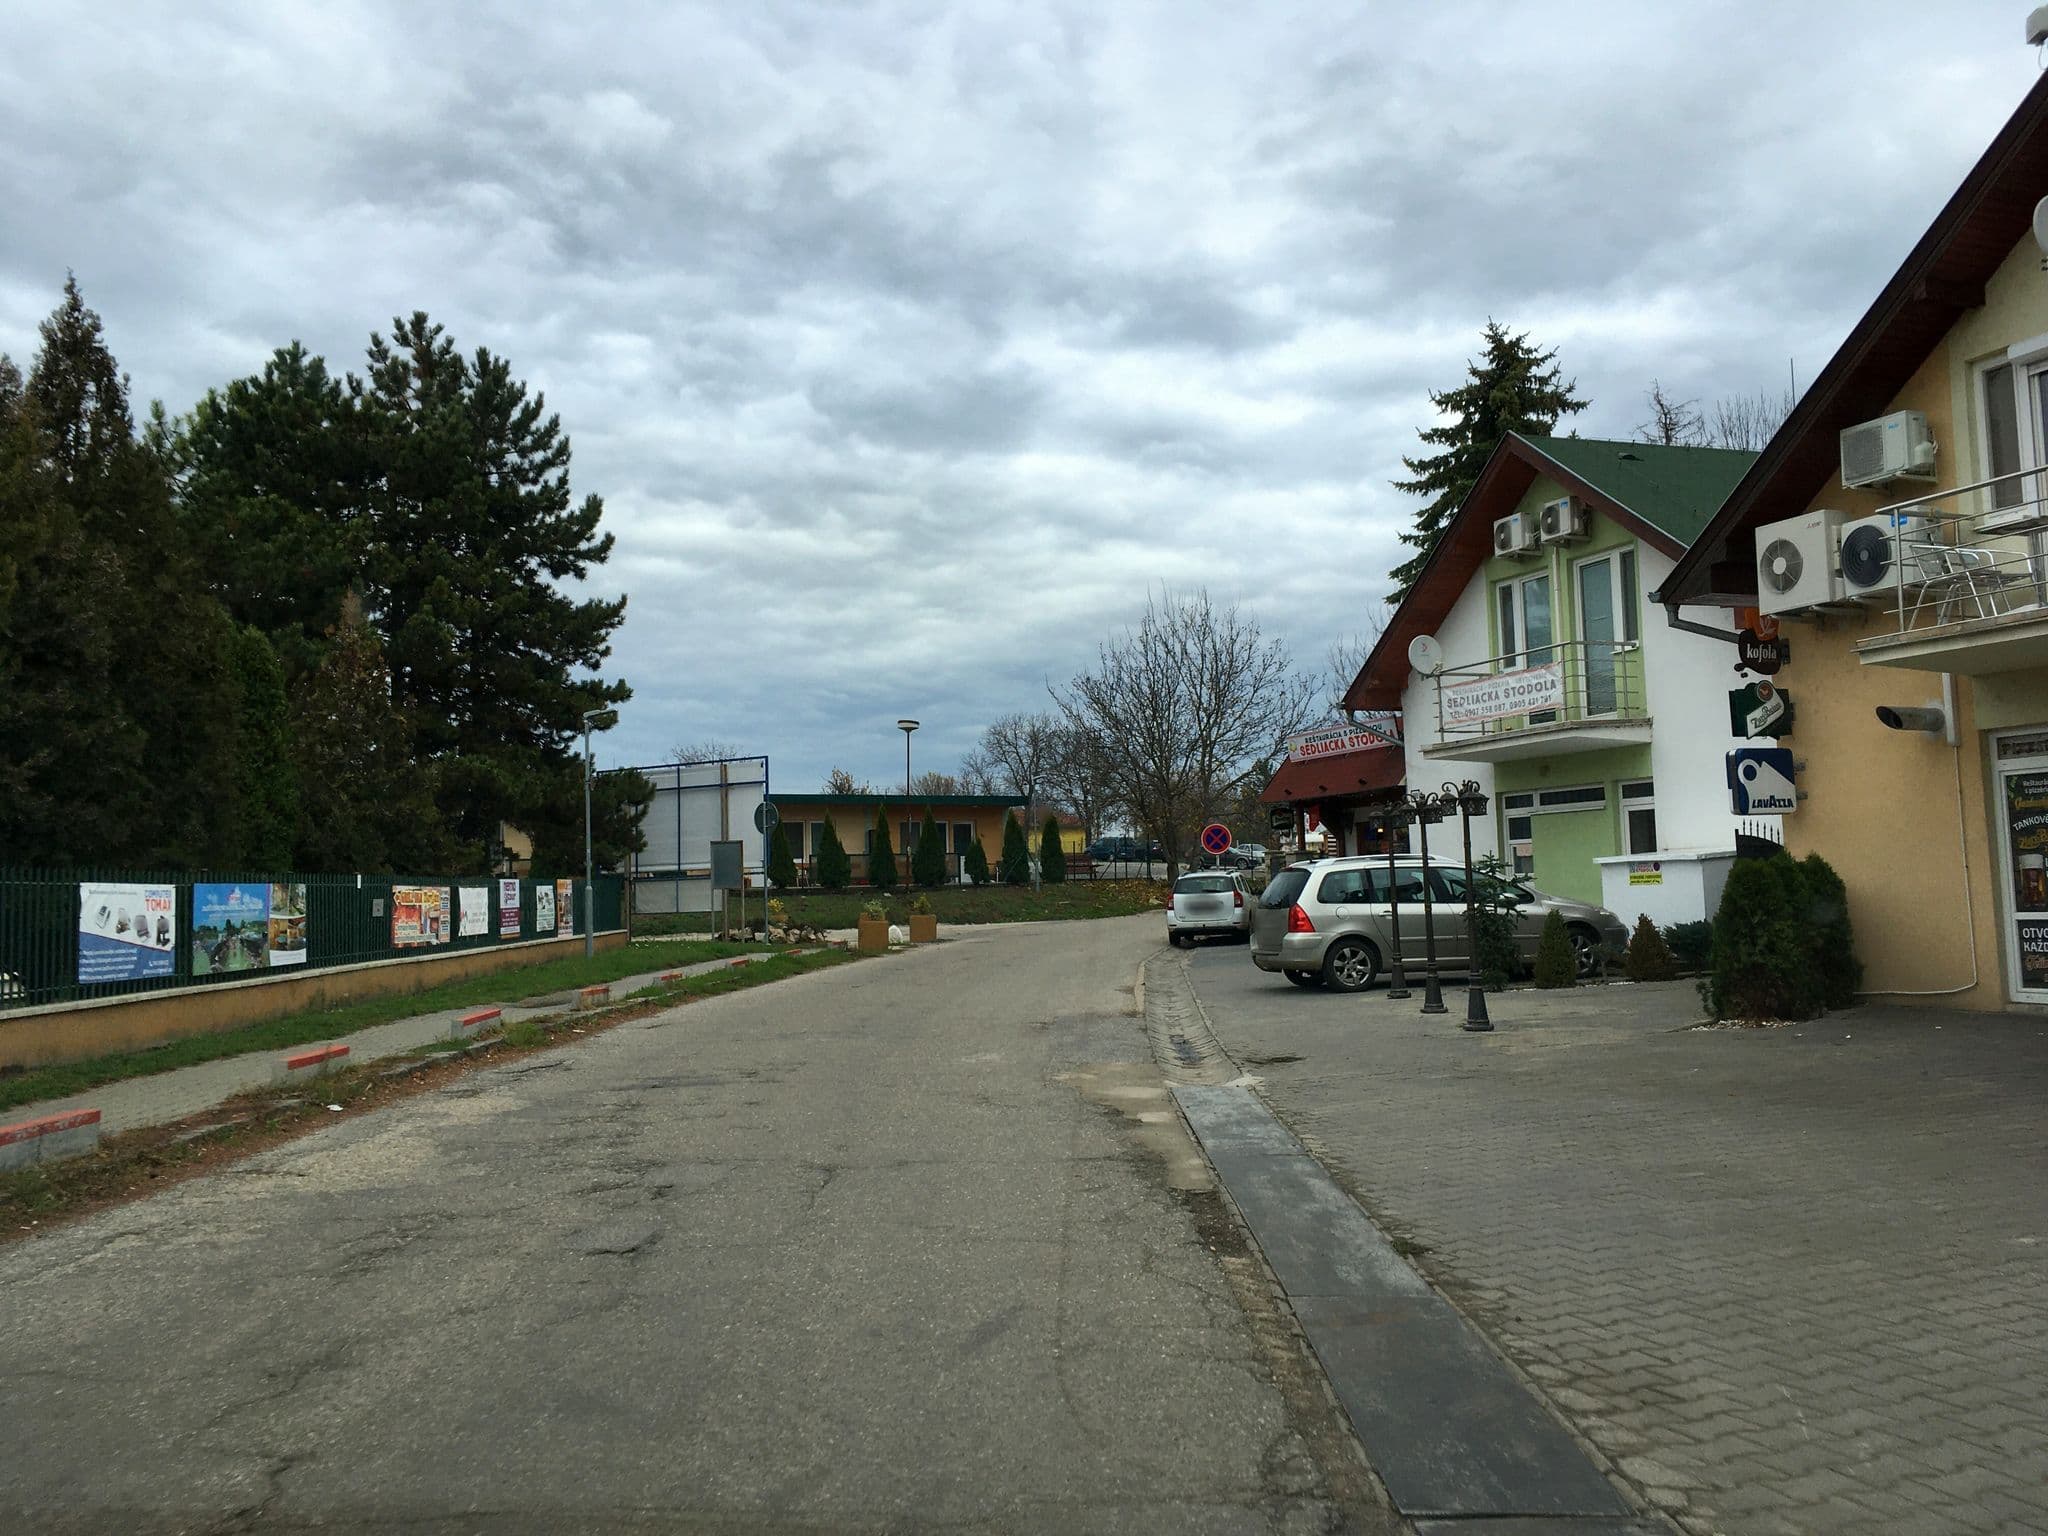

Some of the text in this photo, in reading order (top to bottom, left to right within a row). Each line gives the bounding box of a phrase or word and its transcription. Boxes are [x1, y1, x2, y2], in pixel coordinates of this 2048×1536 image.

[1746, 644, 1777, 662] kofola
[1446, 679, 1557, 709] SEDLIACKA STODOLA
[1300, 740, 1346, 757] SEDLIACKA
[1752, 795, 1794, 810] LAVAZZA
